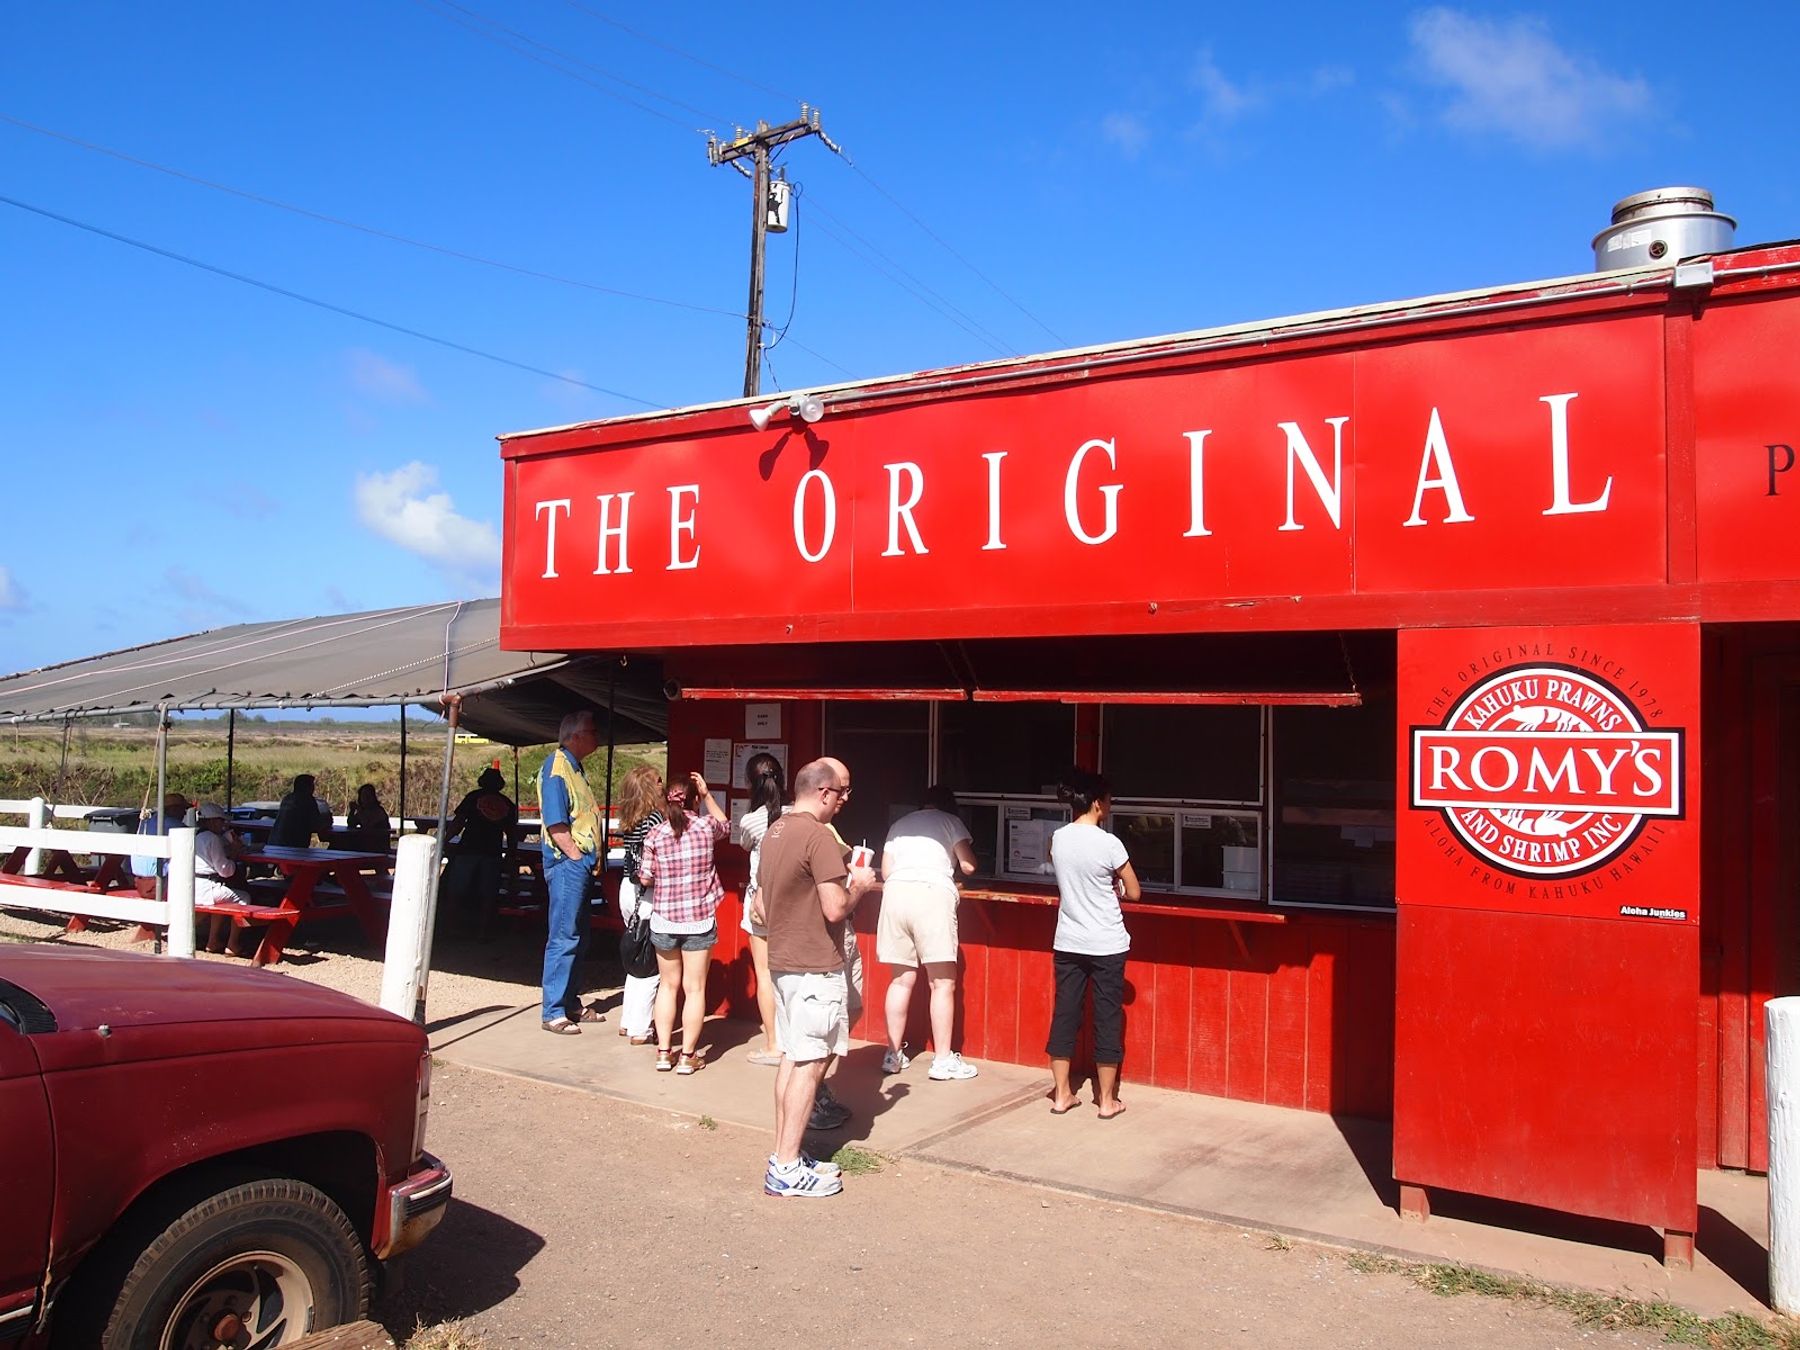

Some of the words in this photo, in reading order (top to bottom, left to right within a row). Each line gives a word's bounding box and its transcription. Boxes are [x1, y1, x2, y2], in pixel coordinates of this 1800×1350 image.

[535, 484, 701, 579] THE
[793, 391, 1613, 564] ORIGINAL
[1426, 685, 1453, 718] THE
[1458, 643, 1554, 681] ORIGINAL
[1568, 646, 1624, 680] SINCE
[1629, 680, 1664, 719] 1978
[1463, 679, 1539, 730] KAHUKU
[1545, 679, 1622, 731] PRAWNS
[1428, 740, 1662, 797] ROMY'S
[1424, 817, 1462, 866] ALOHA
[1470, 866, 1516, 896] FROM
[1528, 878, 1603, 900] KAHUKU
[1611, 826, 1665, 881] HAWAII
[1462, 809, 1499, 844] AND
[1498, 834, 1581, 863] SHRIMP
[1589, 814, 1622, 850] INC
[1620, 906, 1648, 916] Aloha
[1649, 908, 1686, 918] Junkies
